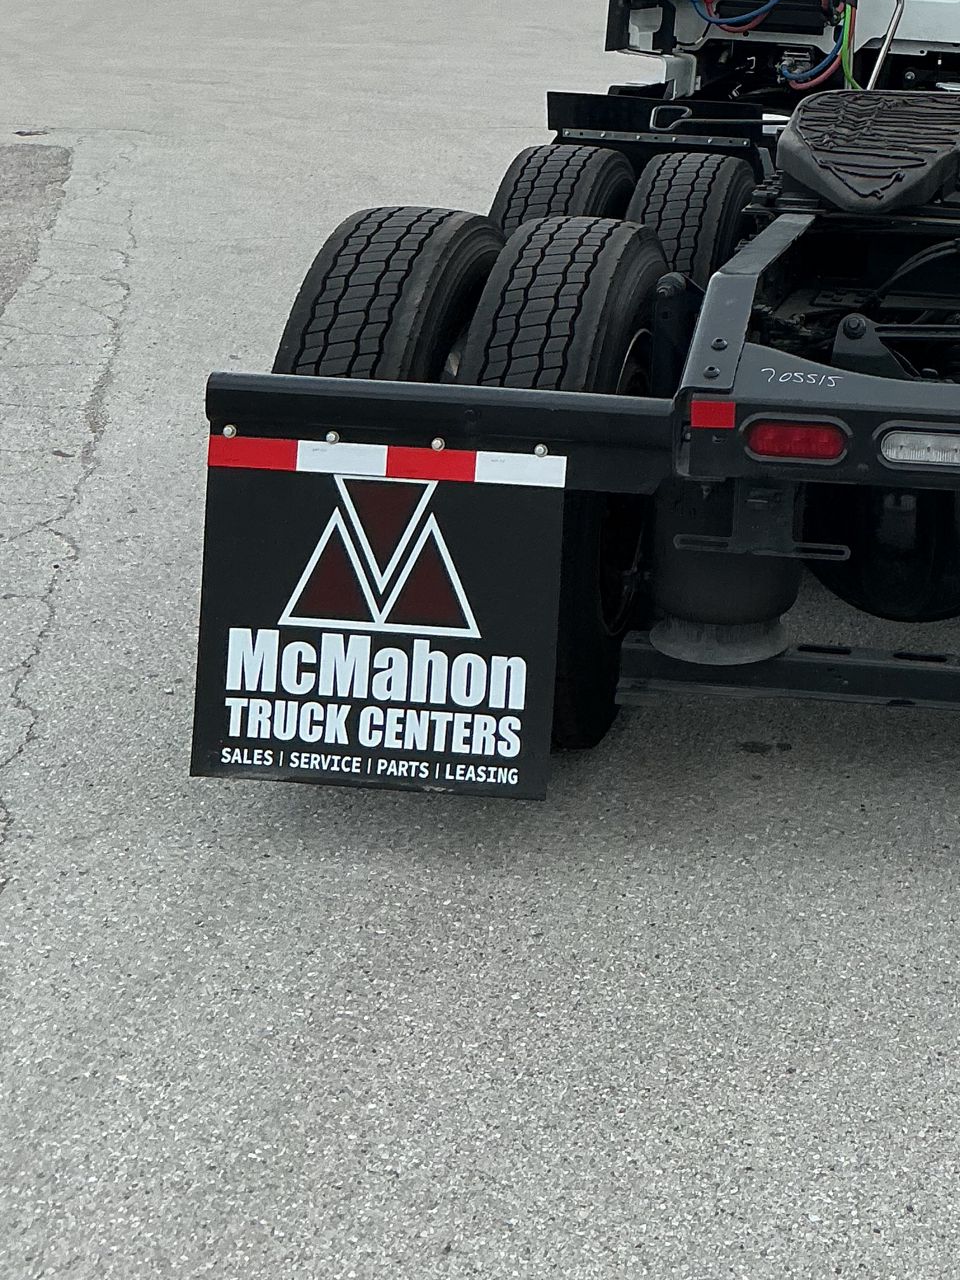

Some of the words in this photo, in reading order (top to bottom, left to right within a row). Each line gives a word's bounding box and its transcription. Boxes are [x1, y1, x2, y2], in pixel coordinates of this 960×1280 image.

[760, 367, 844, 388] 705515
[224, 627, 527, 711] McMahon
[224, 697, 351, 745] TRUCK
[358, 705, 522, 758] CENTERS
[220, 747, 274, 766] SALES
[288, 751, 362, 774] SERVICE
[376, 758, 430, 779] PARTS
[444, 763, 519, 785] LEASING
